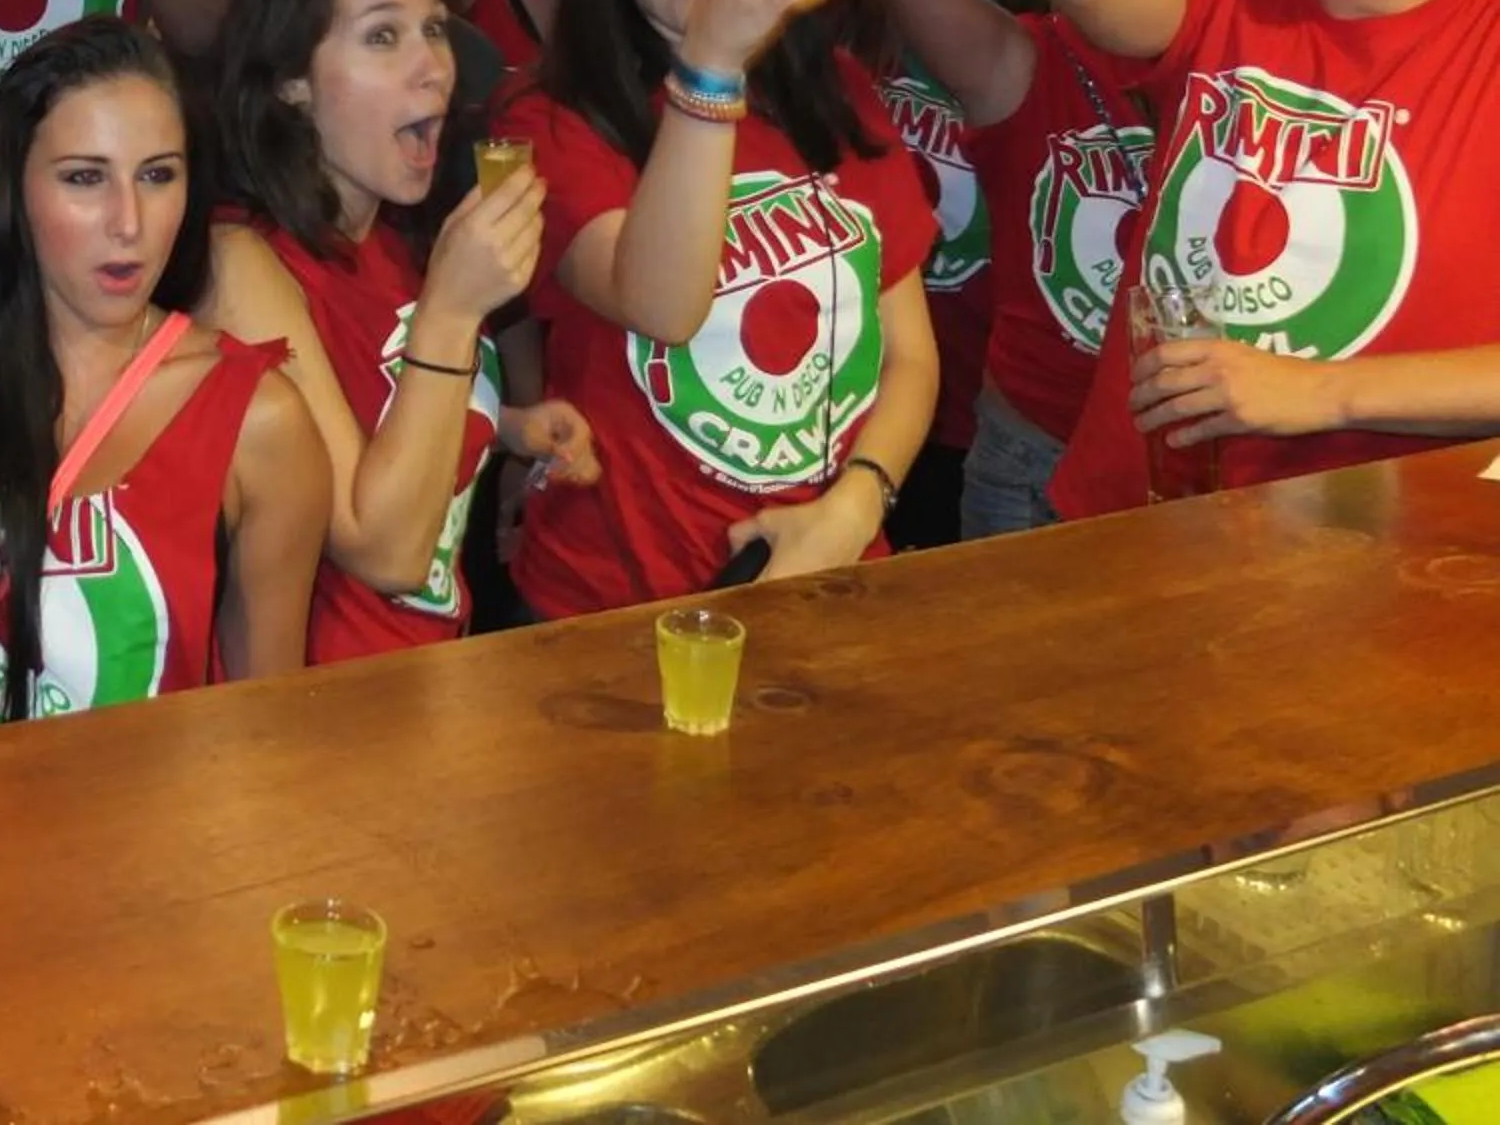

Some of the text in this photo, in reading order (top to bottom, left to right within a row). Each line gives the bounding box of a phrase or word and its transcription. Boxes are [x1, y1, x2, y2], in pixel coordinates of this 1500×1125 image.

[720, 192, 851, 281] MINI
[1187, 236, 1213, 280] PUB
[1222, 276, 1293, 314] DISCO
[719, 366, 763, 408] PUB
[792, 351, 832, 410] DISCO
[687, 393, 857, 470] CRAWL
